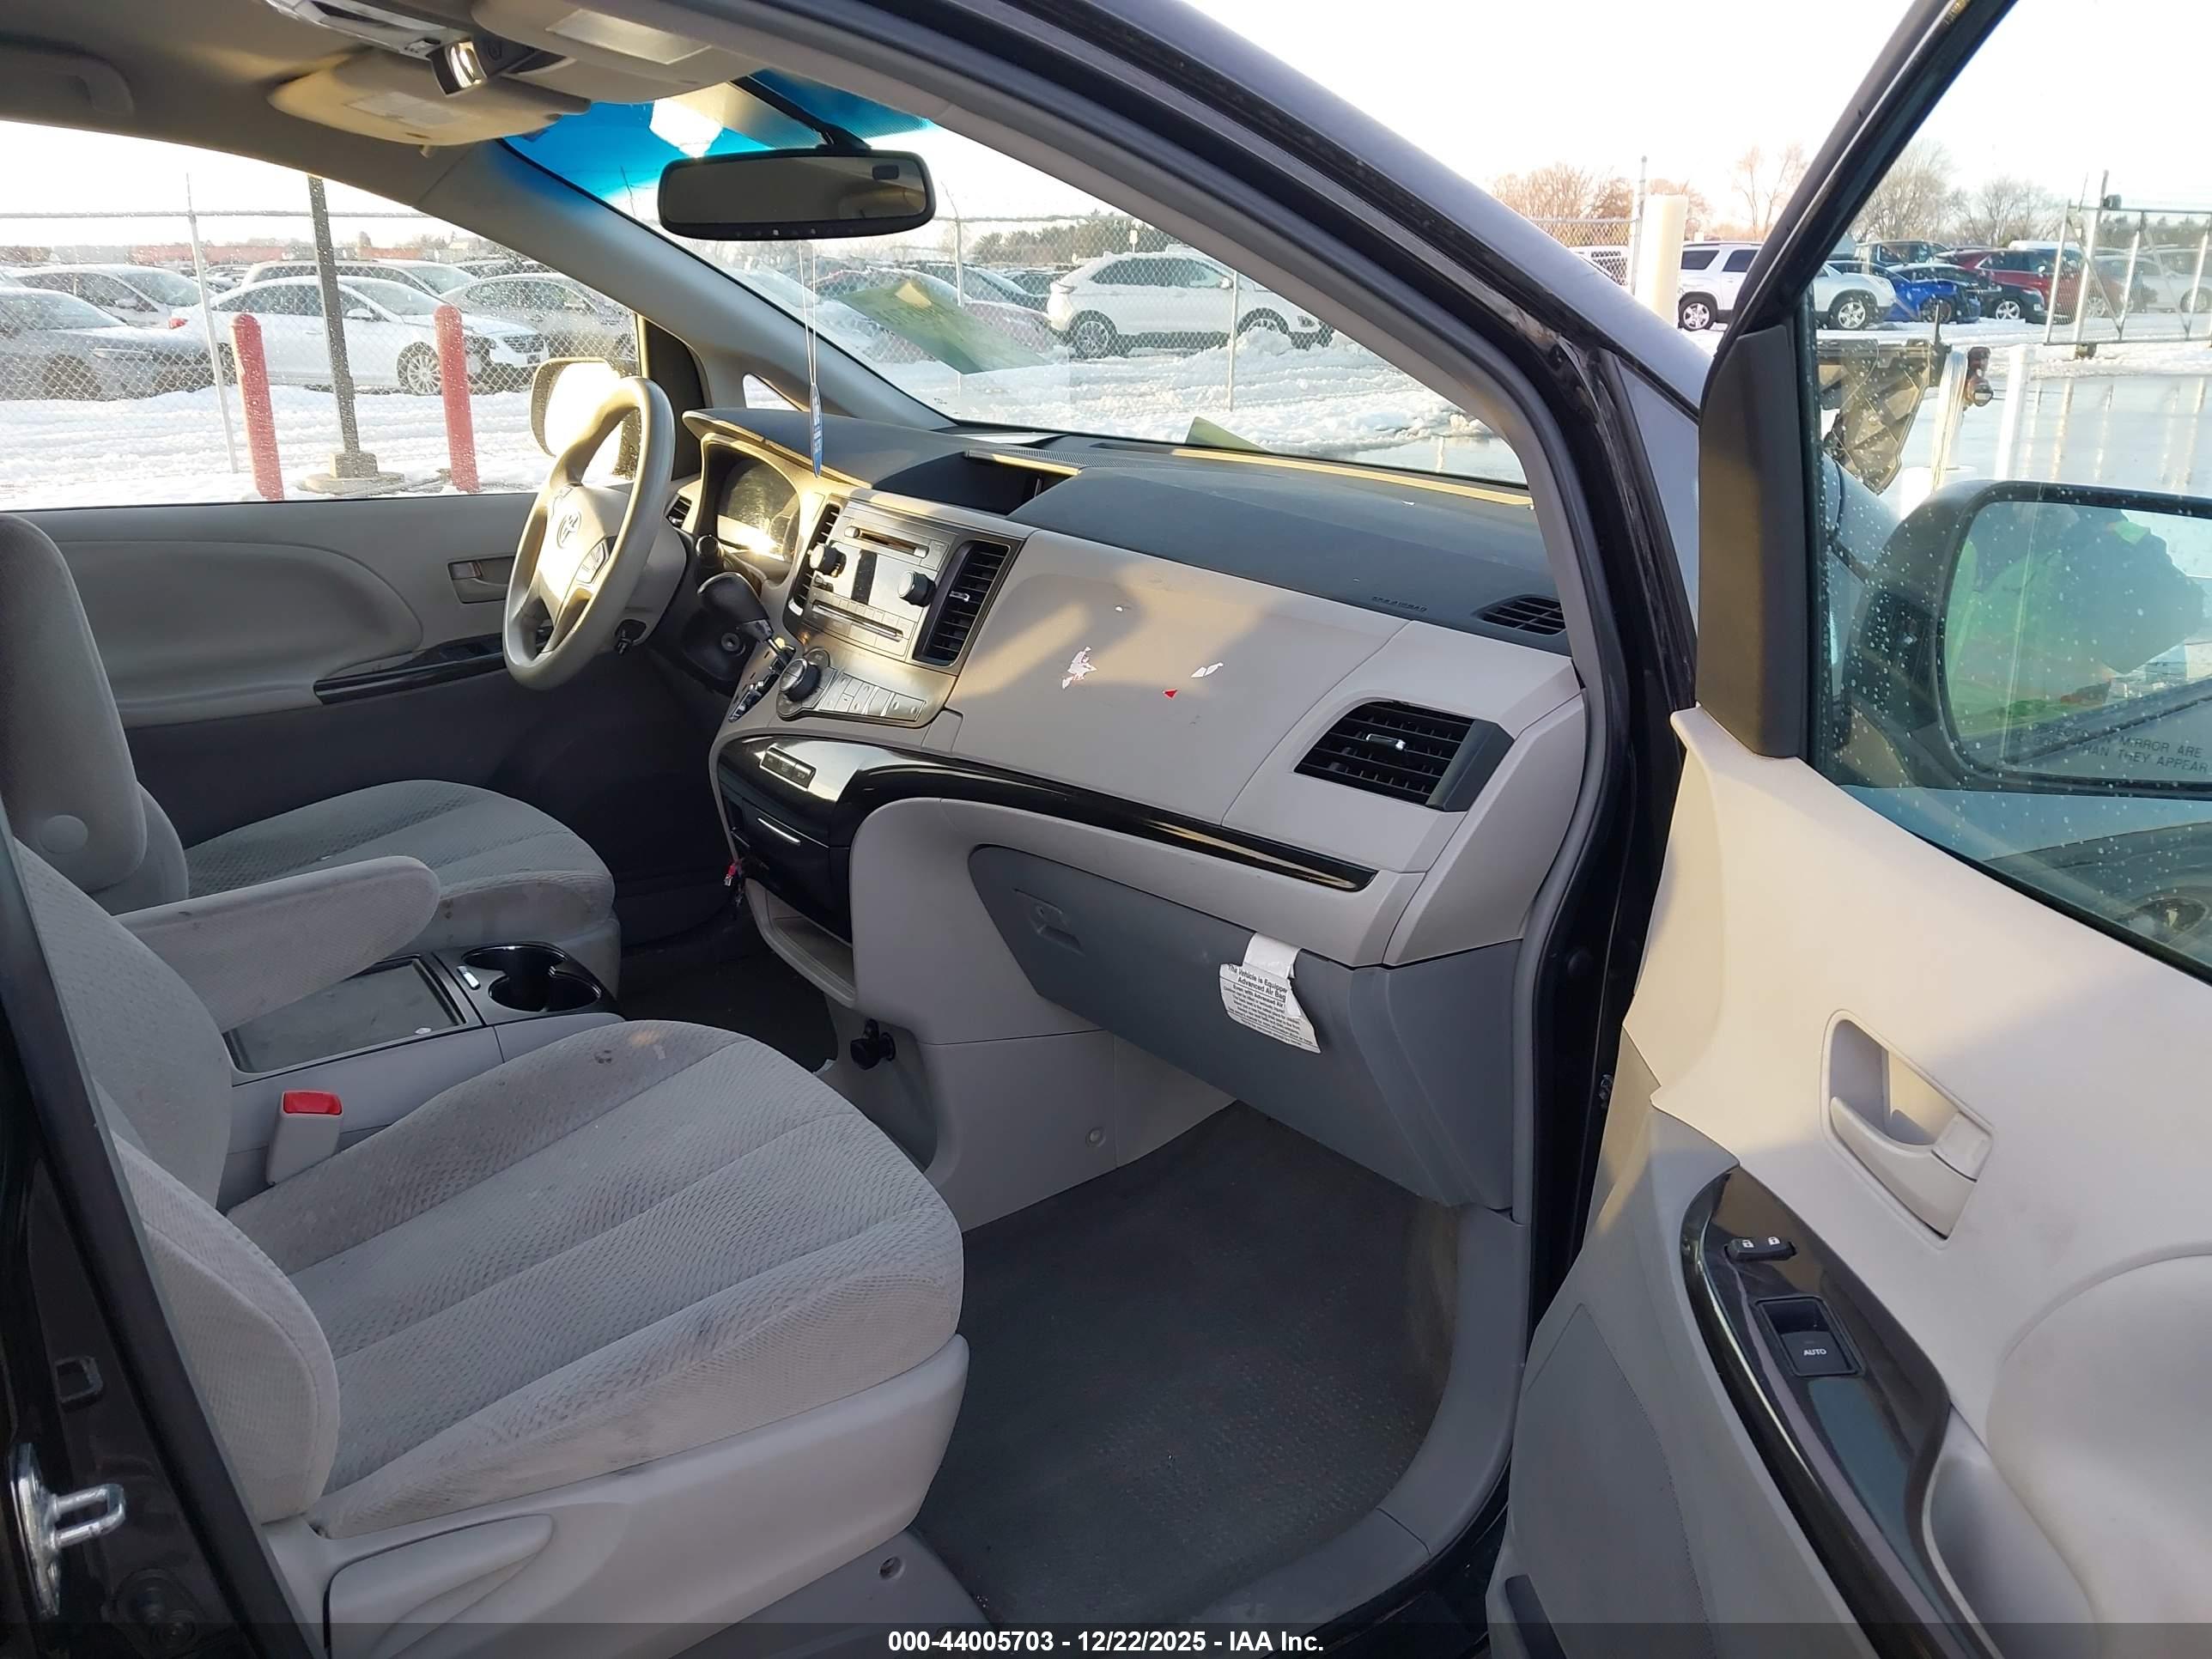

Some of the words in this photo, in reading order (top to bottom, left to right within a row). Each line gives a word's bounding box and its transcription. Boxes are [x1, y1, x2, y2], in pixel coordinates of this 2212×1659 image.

[2120, 736, 2170, 752] MIRROR
[2177, 744, 2204, 758] ARE
[2118, 749, 2151, 763] THEY
[2156, 756, 2209, 773] APPEAR
[1238, 976, 1264, 992] Advanced
[1266, 987, 1274, 996] Air
[1264, 977, 1287, 994] Equippe
